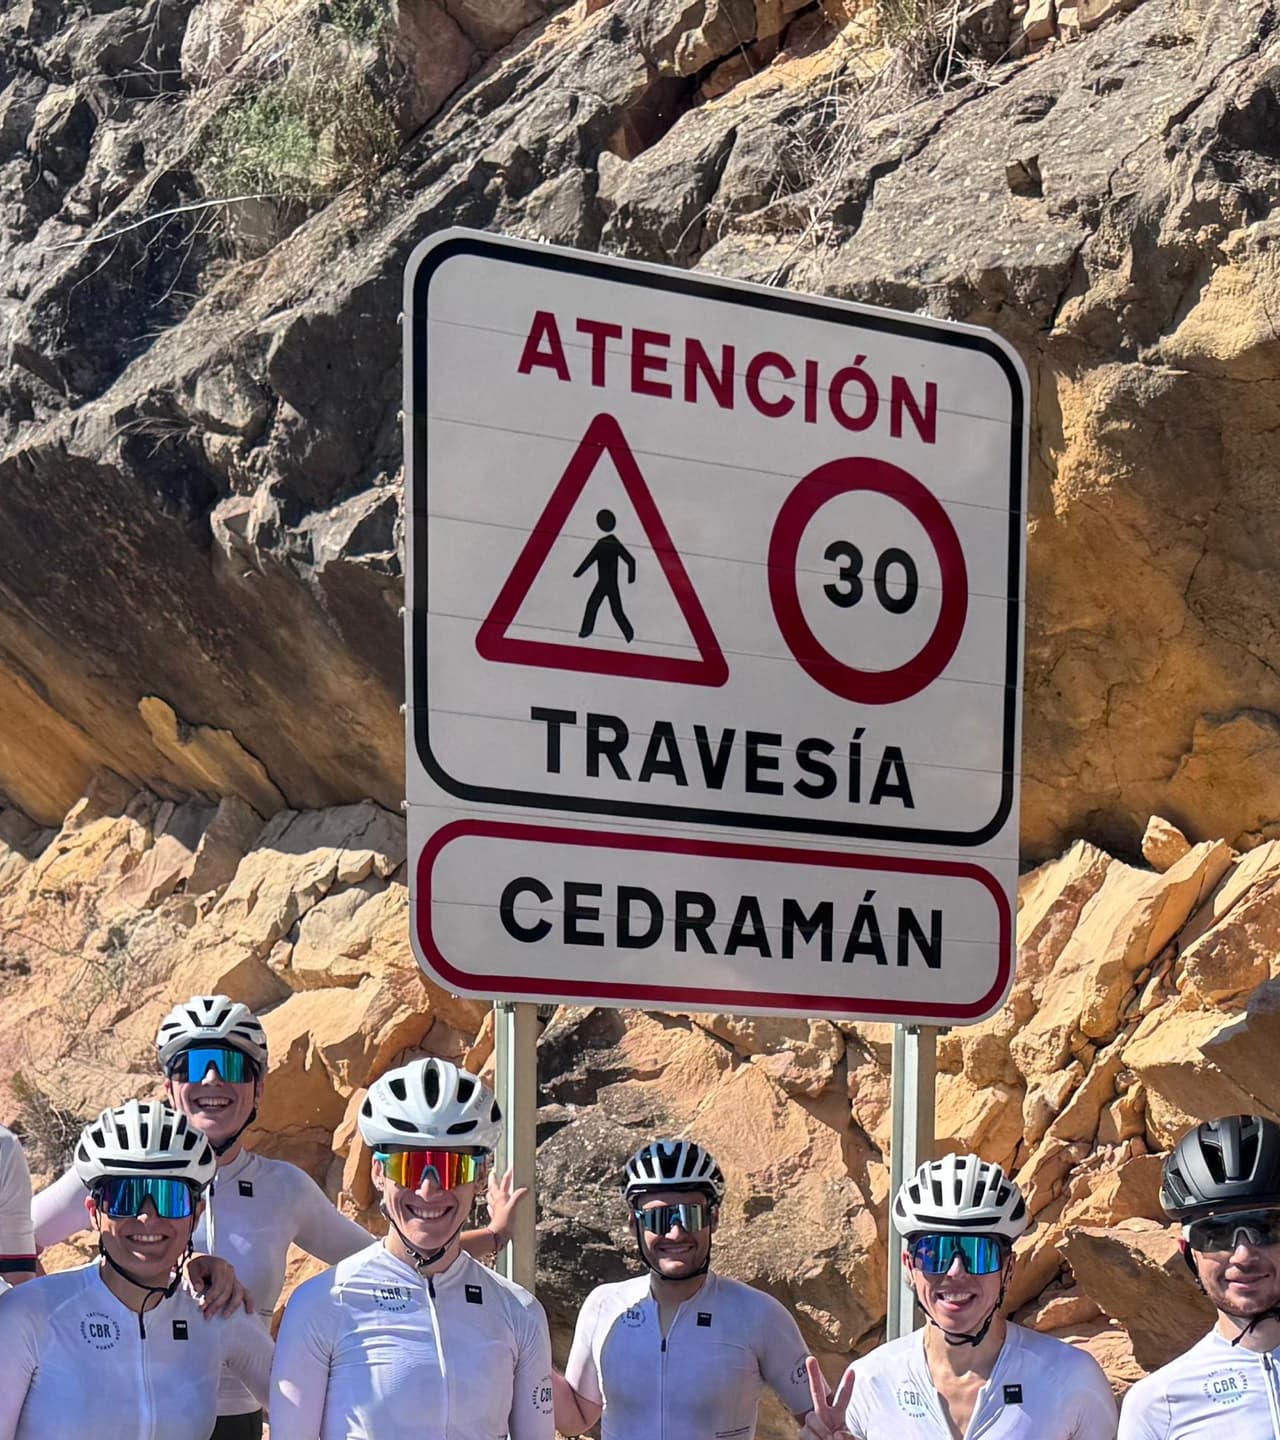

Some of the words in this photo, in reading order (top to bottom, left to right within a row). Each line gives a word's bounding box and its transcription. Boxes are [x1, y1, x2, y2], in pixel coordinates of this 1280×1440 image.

[516, 310, 939, 445] ATENCIÓN
[823, 540, 919, 614] 30
[530, 705, 917, 810] TRAVESÍA
[499, 875, 943, 970] CEDRAMÁN
[89, 1323, 112, 1339] CBR
[1213, 1377, 1238, 1394] CBR
